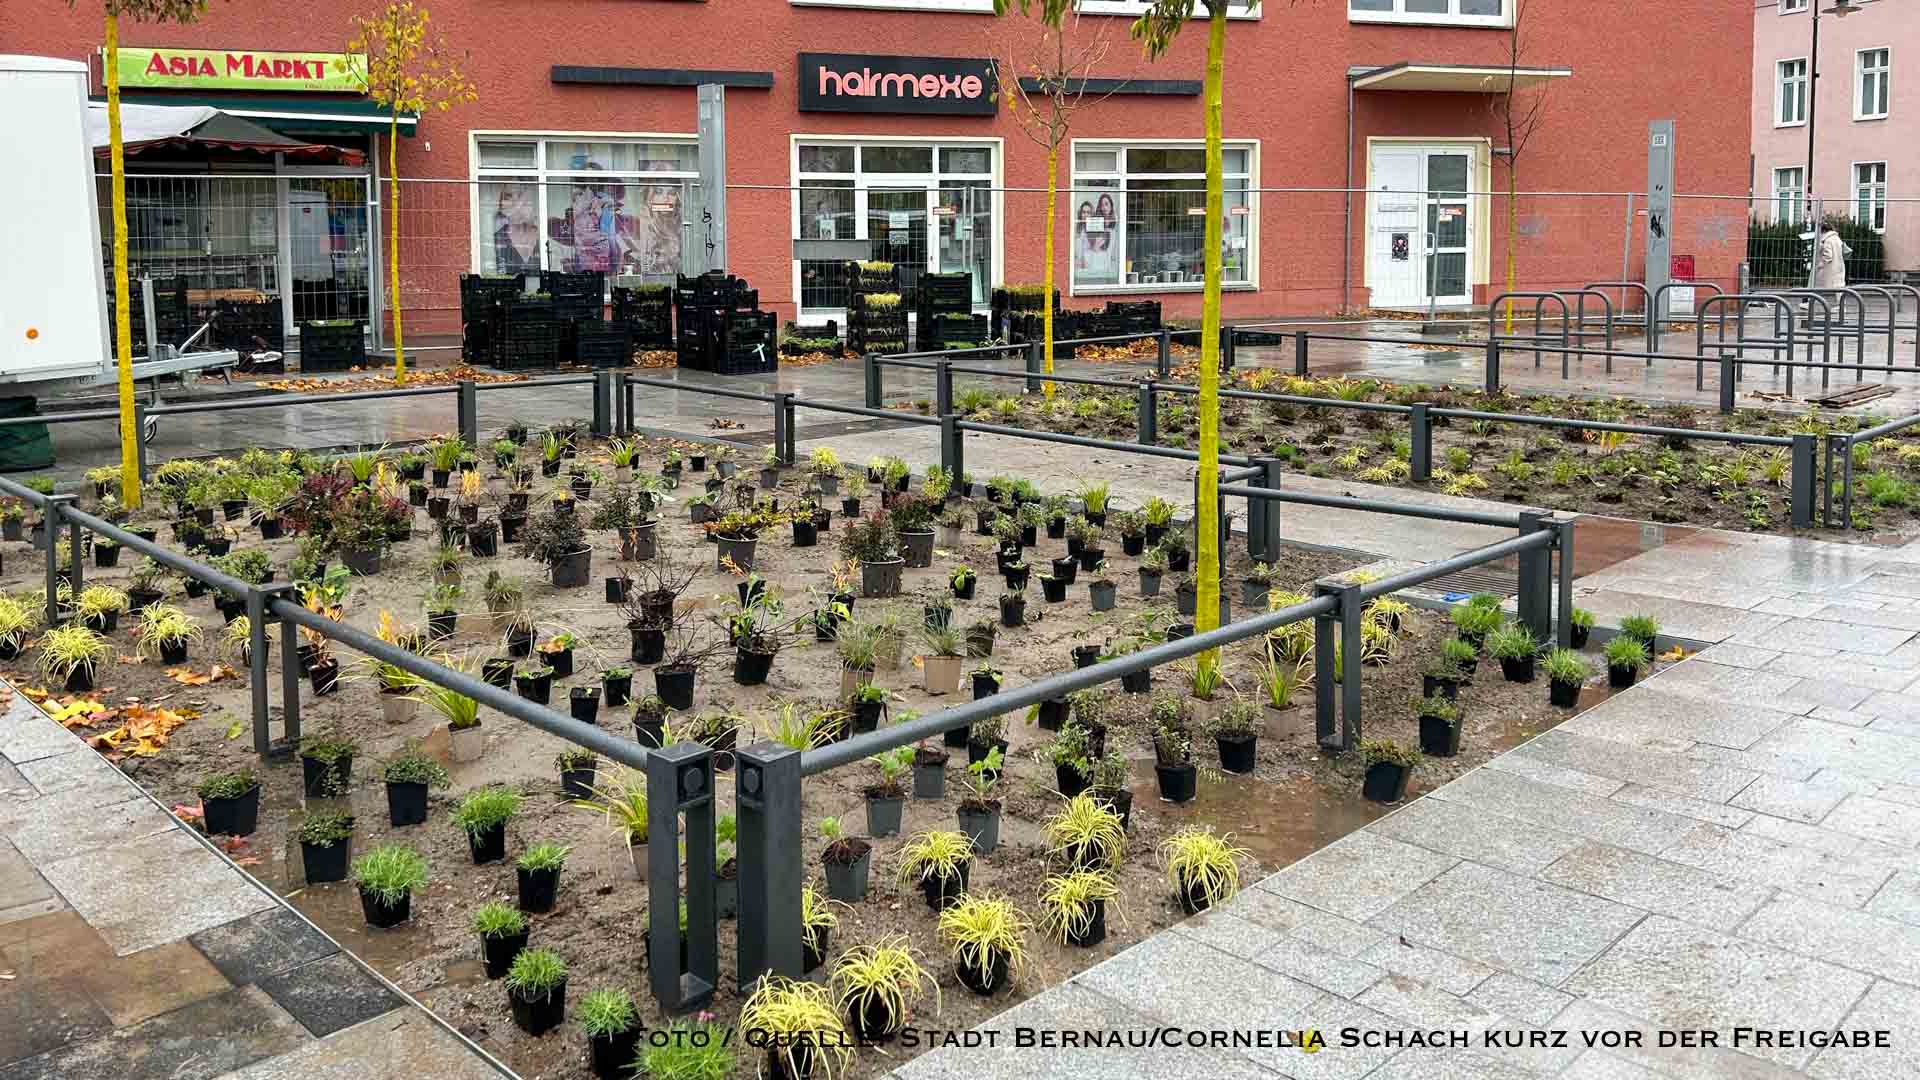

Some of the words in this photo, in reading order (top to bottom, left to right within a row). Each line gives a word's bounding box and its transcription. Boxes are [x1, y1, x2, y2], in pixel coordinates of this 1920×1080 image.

[145, 52, 217, 77] ASIA
[226, 53, 328, 80] MARKT
[819, 65, 983, 99] hairmexe
